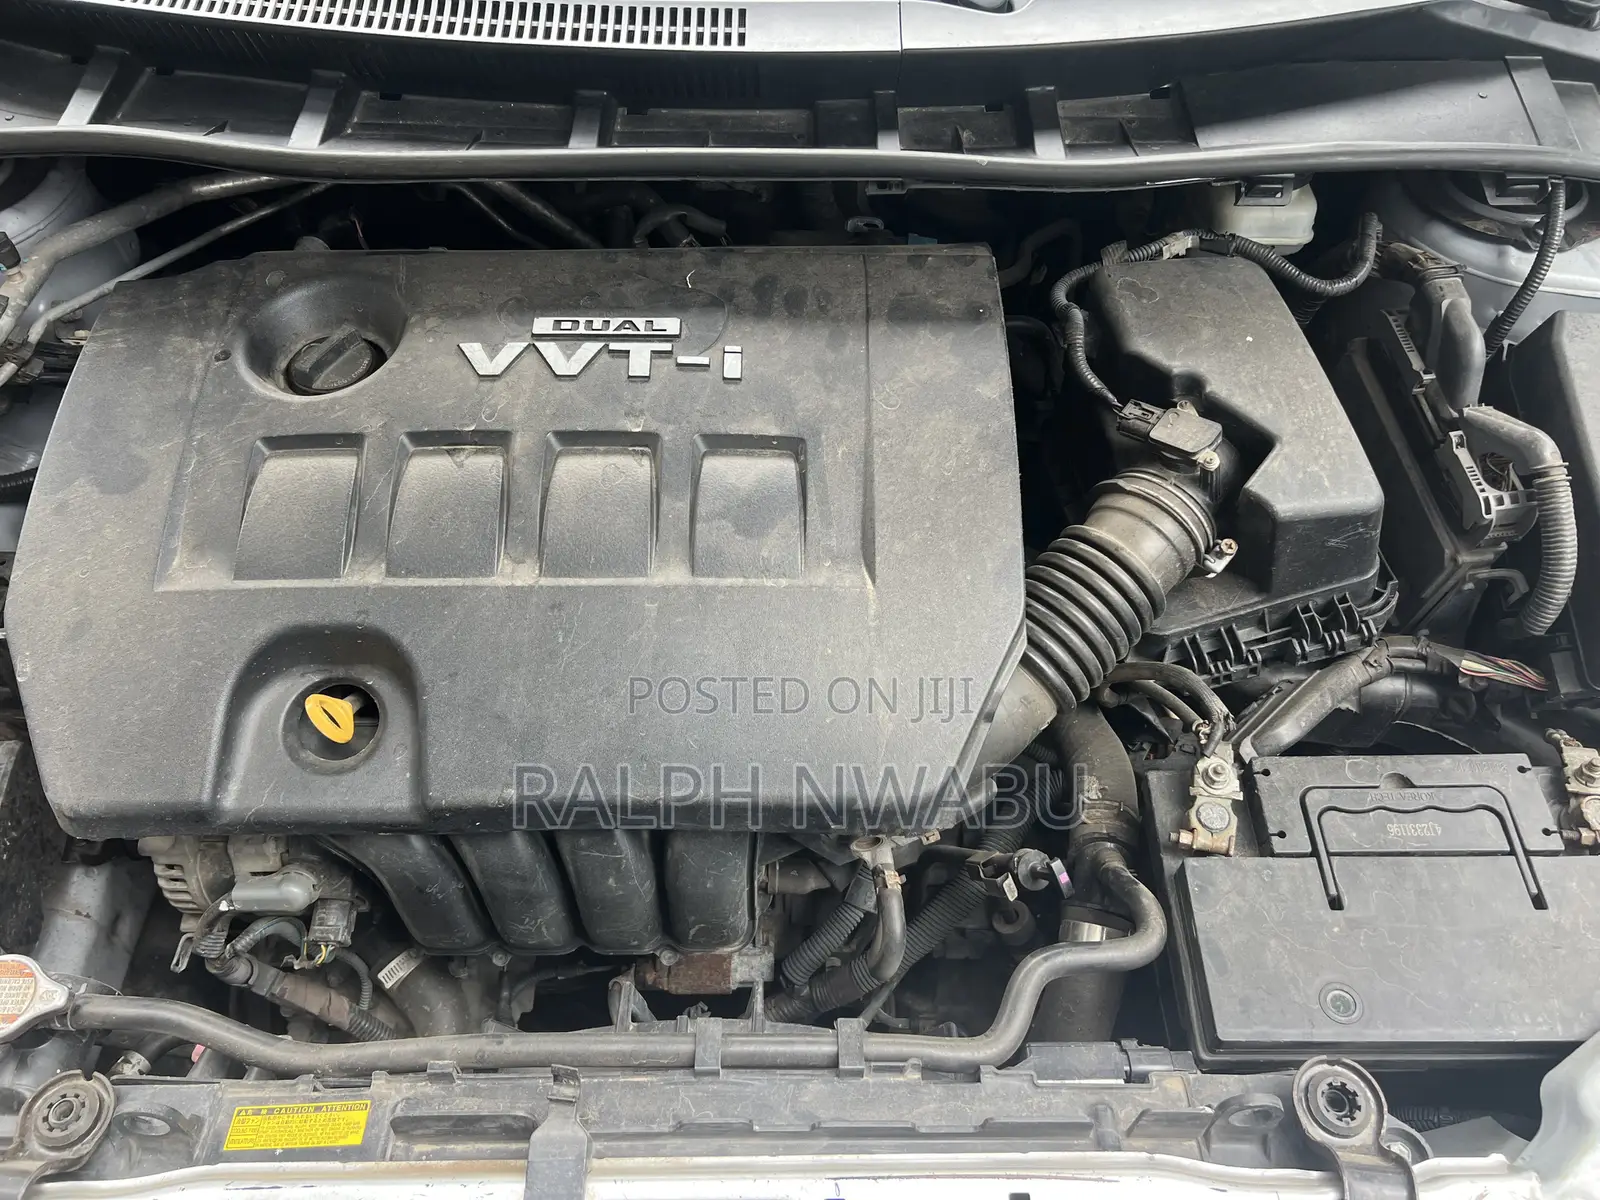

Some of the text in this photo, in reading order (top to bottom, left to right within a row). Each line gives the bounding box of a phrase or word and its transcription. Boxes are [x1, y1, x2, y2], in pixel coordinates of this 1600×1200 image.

[552, 319, 668, 332] DUAL
[457, 342, 743, 381] VVT-i
[273, 1106, 315, 1114] CAUTION
[320, 1103, 366, 1112] ATTENTION
